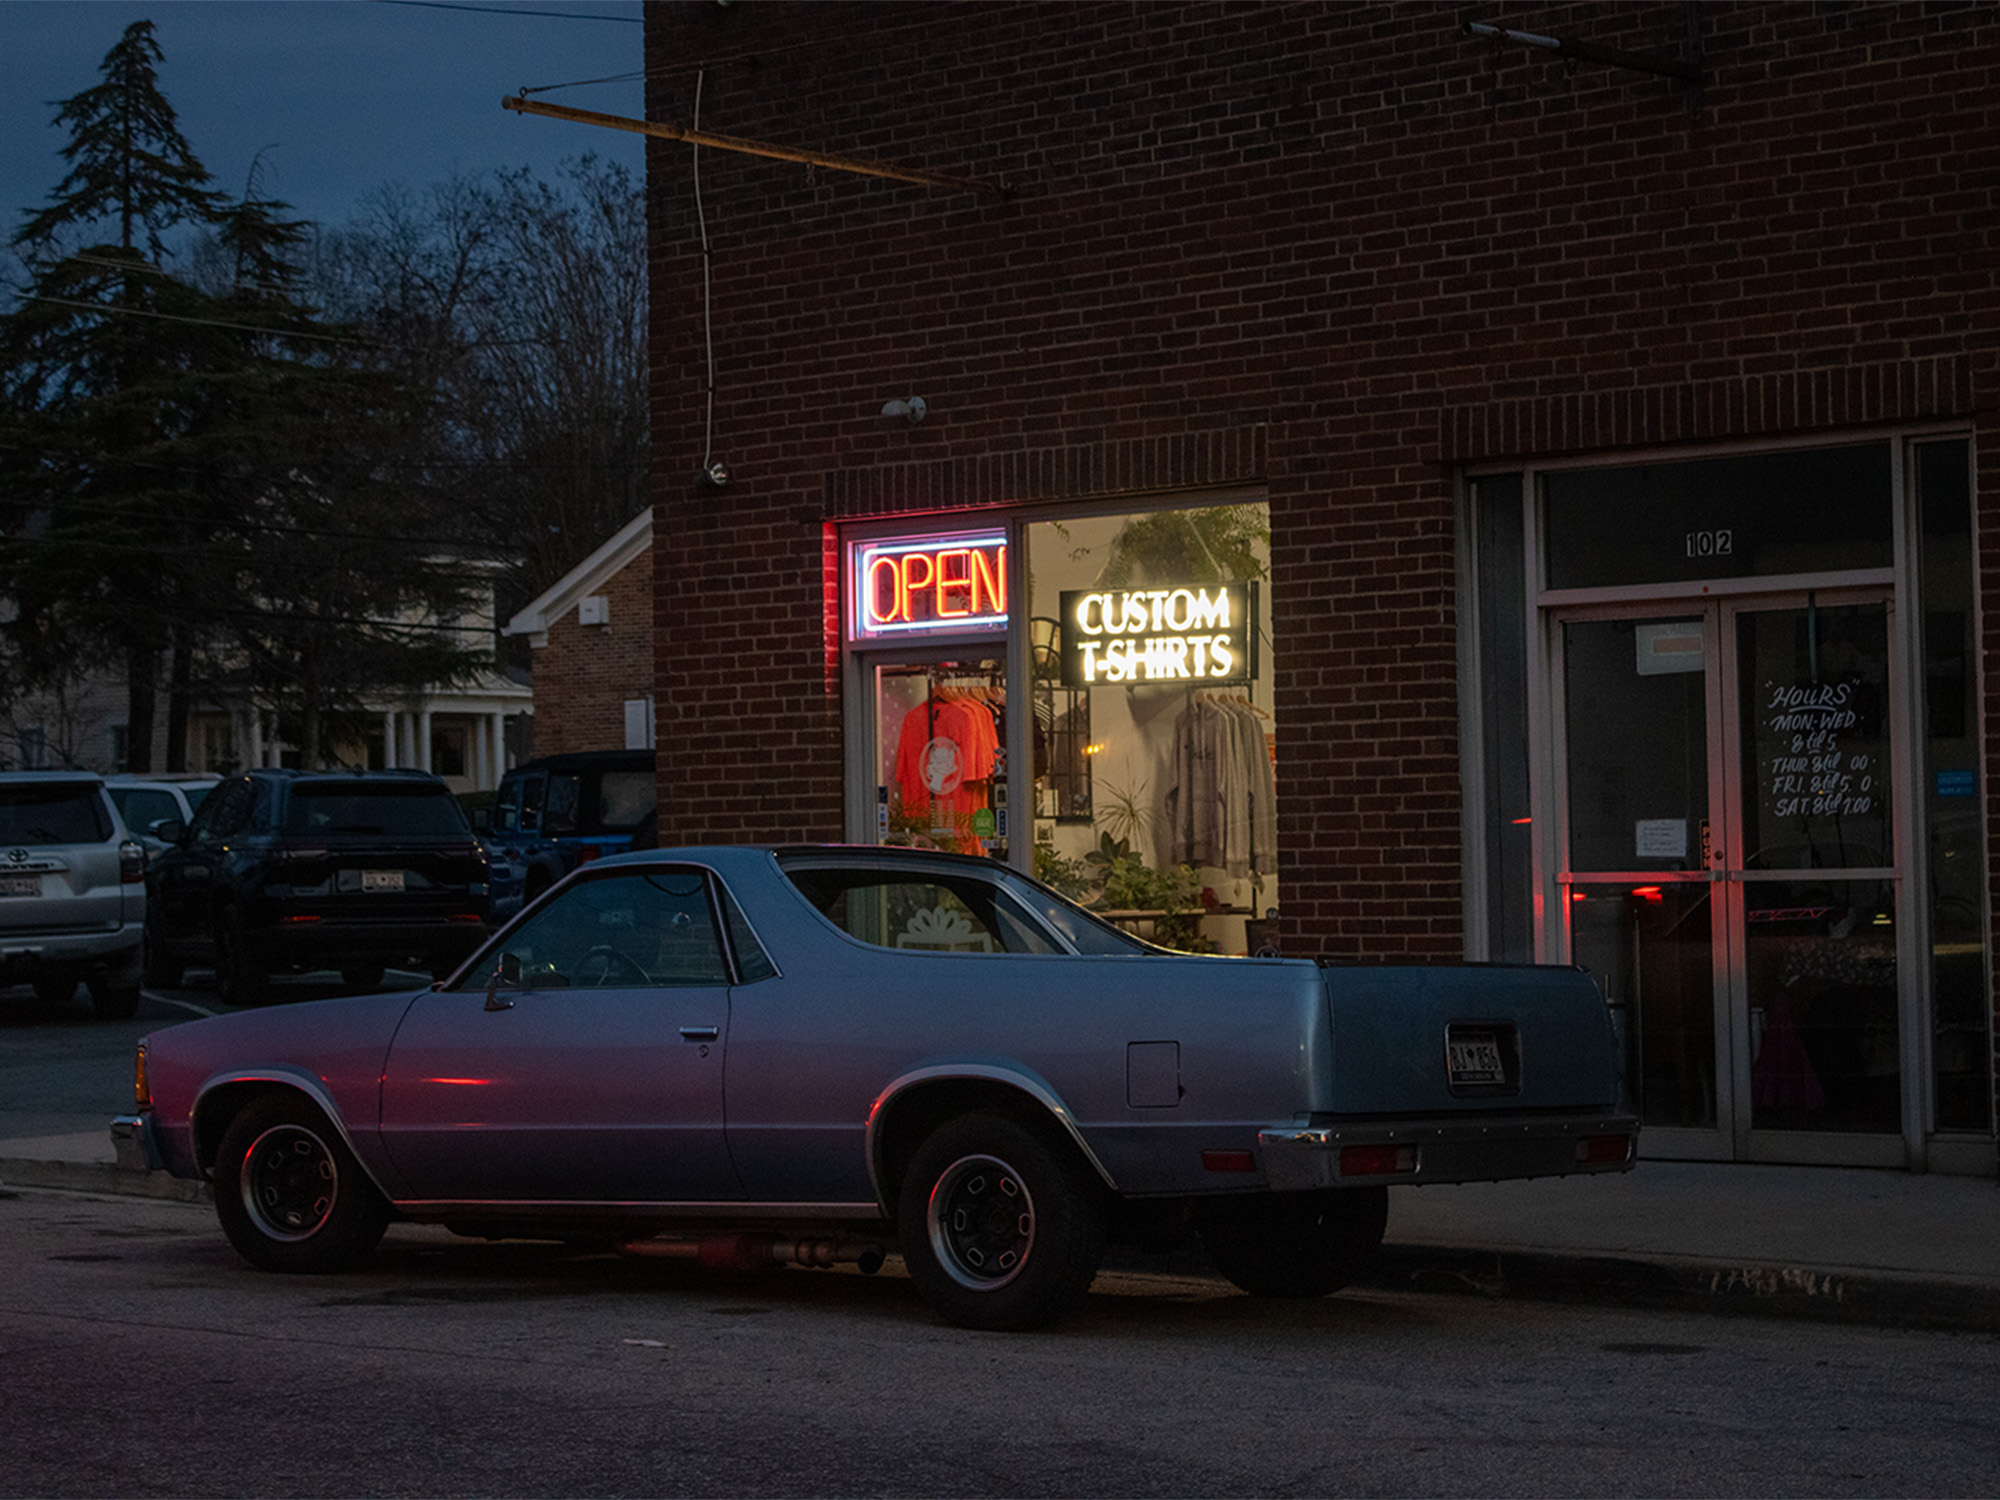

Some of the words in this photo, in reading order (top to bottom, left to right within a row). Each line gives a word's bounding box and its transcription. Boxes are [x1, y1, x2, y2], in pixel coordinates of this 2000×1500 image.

[1688, 531, 1731, 556] 102
[869, 546, 1007, 623] OPEN
[1077, 586, 1230, 635] CUSTOM
[1077, 634, 1232, 682] T-SHIRTS
[1791, 733, 1804, 754] 8
[1811, 756, 1823, 774] 8
[1810, 775, 1822, 793] 8
[1812, 797, 1824, 815] 8
